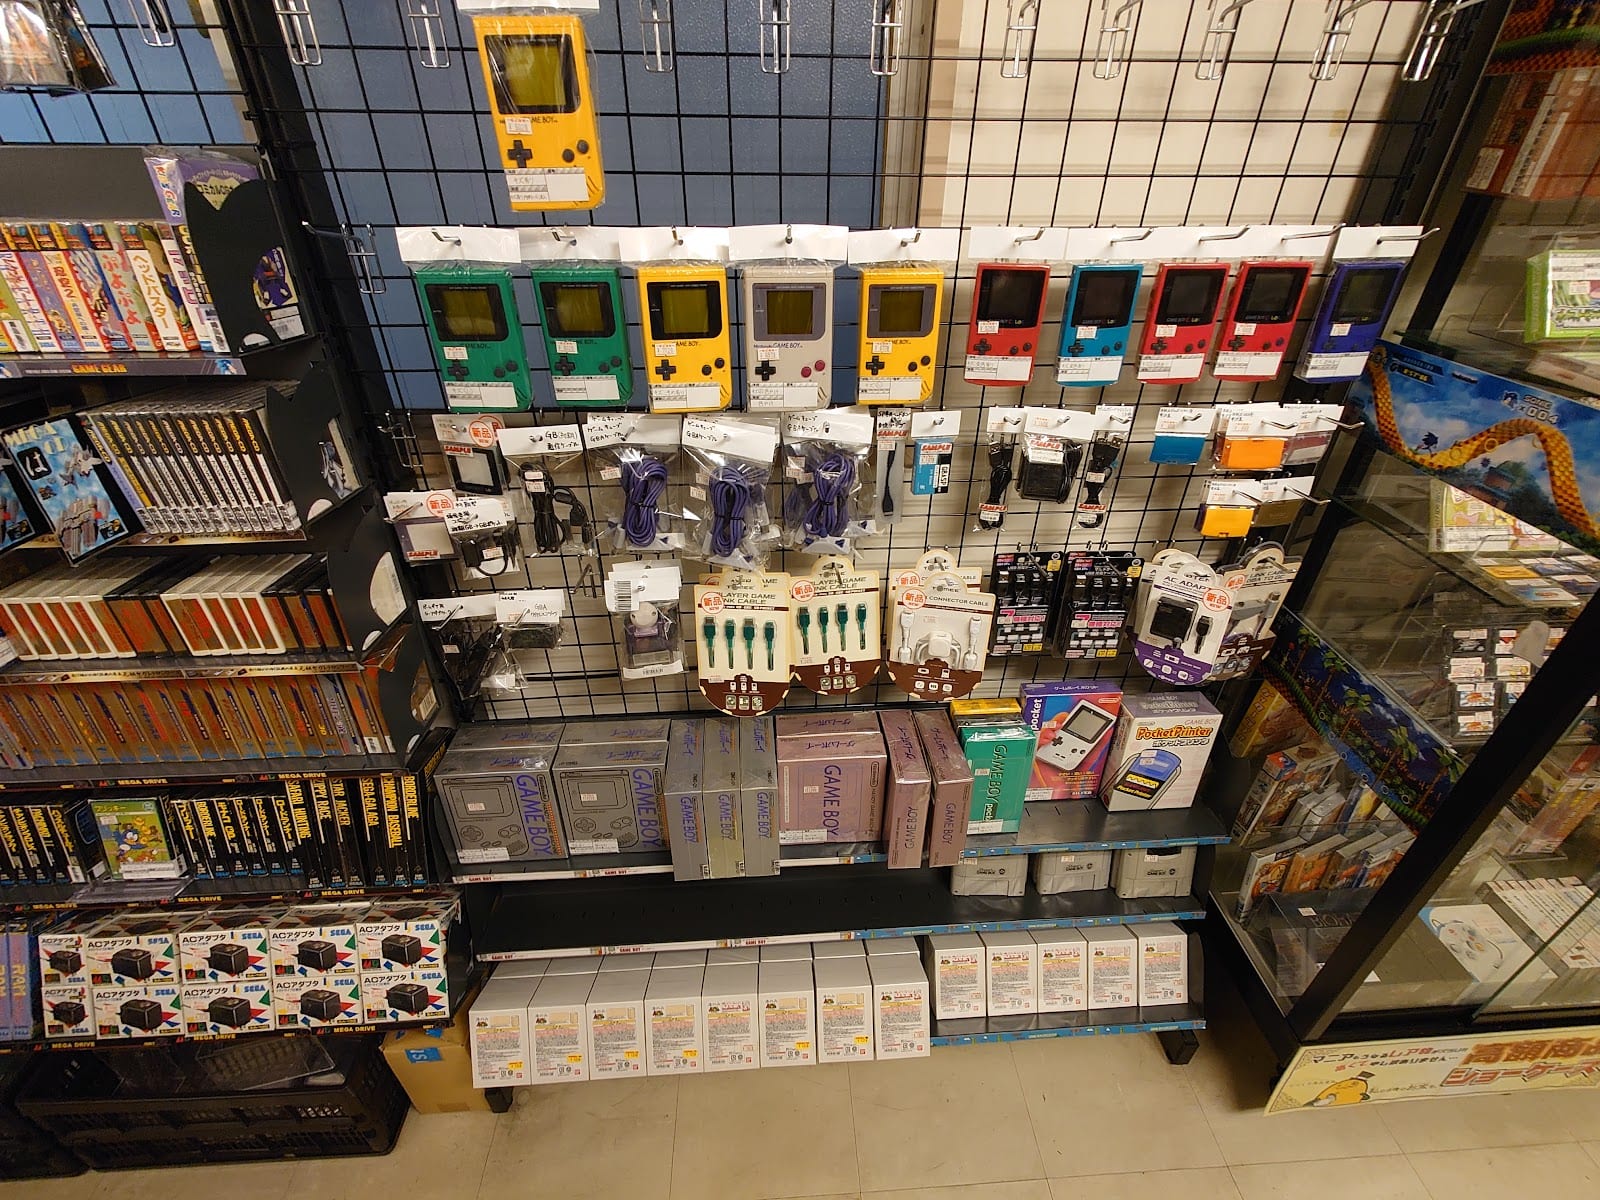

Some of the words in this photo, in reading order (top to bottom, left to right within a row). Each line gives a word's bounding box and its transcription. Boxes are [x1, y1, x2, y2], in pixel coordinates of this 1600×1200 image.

[131, 253, 170, 329] ヘッドバスター
[72, 363, 99, 374] GAME
[101, 362, 128, 374] GEAR
[1523, 394, 1553, 410] SONIC
[1527, 406, 1559, 425] 004
[472, 428, 492, 439] 新品
[444, 445, 471, 454] SAMPLE
[25, 451, 48, 477] は
[429, 499, 451, 510] 新品
[408, 550, 438, 558] SAMPLE
[901, 575, 918, 585] 新品
[1164, 575, 1177, 583] AC
[1179, 579, 1207, 591] ADAP
[750, 592, 776, 600] GAME
[794, 586, 813, 596] 新品
[905, 592, 925, 604] 新品
[1206, 592, 1228, 606] 新品
[703, 597, 723, 607] 新品
[928, 595, 968, 606] CONNECTOR
[1030, 698, 1043, 731] pocket
[805, 740, 856, 750] ゲームボーイ
[990, 744, 1008, 780] GAME
[288, 780, 304, 806] SAFARI
[332, 778, 345, 797] STAR
[382, 775, 397, 812] CHAMPION
[632, 768, 658, 816] GAME
[824, 764, 841, 808] GAME
[986, 780, 1001, 804] BOY
[361, 777, 380, 827] SEGA-GALAGA
[403, 775, 419, 820] BORDERLINE
[516, 774, 545, 824] GAME
[757, 791, 769, 820] GAME
[94, 803, 128, 813] フリッキー
[316, 800, 332, 820] RACE
[335, 799, 351, 826] JACKER
[681, 796, 694, 826] GAME
[718, 793, 732, 822] GAME
[907, 806, 918, 822] BOY
[293, 807, 311, 839] HUNTING
[822, 810, 840, 836] BOY
[944, 802, 957, 831] GAME
[388, 814, 403, 847] BASEBALL
[639, 818, 661, 849] BOY
[683, 826, 697, 843] BOY
[720, 823, 732, 840] BOY
[758, 821, 770, 839] BOY
[904, 821, 917, 849] GAME
[942, 830, 953, 845] BOY
[527, 826, 552, 858] BOY
[271, 930, 316, 940] ACアダプタ
[330, 928, 351, 937] SEGA
[359, 924, 401, 934] ACアダプタ
[414, 923, 436, 931] SEGA
[88, 938, 133, 949] ACアダプタ
[147, 936, 169, 945] SEGA
[182, 934, 227, 944] ACアダプタ
[241, 931, 263, 940] SEGA
[12, 963, 27, 997] RAM
[334, 978, 356, 987] SEGA
[363, 974, 407, 984] ACアダプタ
[421, 972, 443, 980] SEGA
[155, 987, 177, 997] SEGA
[184, 987, 229, 998] ACアダプタ
[244, 985, 266, 993] SEGA
[276, 980, 319, 989] ACアダプタ
[96, 989, 141, 1000] ACアダプタ
[215, 1033, 236, 1041] DRIVE
[354, 1025, 376, 1033] DRIVE
[1440, 1058, 1600, 1087] ショーケース
